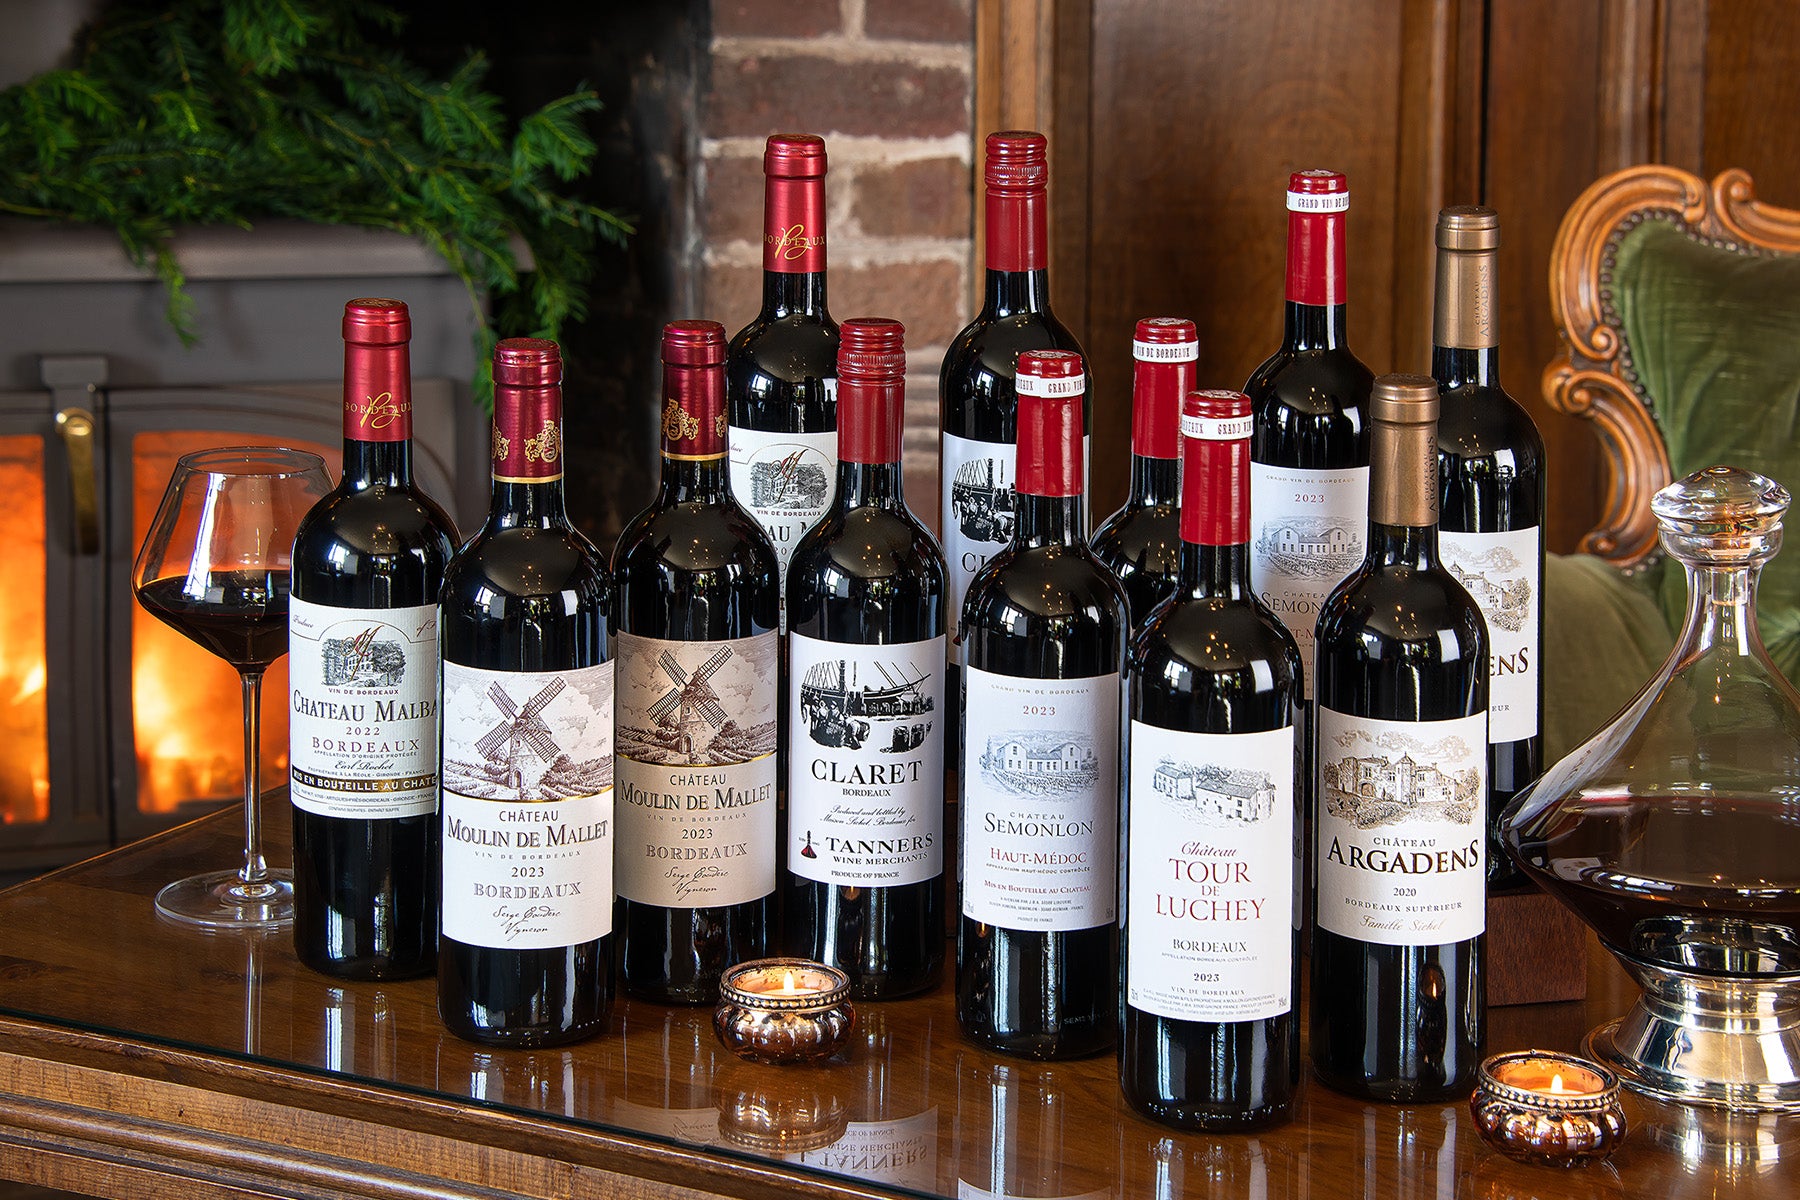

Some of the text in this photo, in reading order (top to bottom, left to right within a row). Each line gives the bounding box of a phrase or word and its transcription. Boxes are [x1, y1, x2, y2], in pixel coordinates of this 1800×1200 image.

[1298, 198, 1318, 208] GRAND
[1480, 264, 1488, 337] ARGADENS
[1156, 347, 1190, 358] BORDEAUX
[1048, 382, 1071, 394] GRAND
[1218, 423, 1240, 435] GRAND
[1428, 436, 1436, 512] ARGADENS
[1294, 493, 1326, 504] 2023
[1284, 590, 1327, 599] CHATEA
[1261, 592, 1323, 615] SEMON
[991, 684, 1014, 692] GRAND
[294, 690, 365, 722] CHATEAU
[1023, 705, 1056, 716] 2023
[346, 726, 380, 736] 2022
[312, 736, 420, 753] BORDEAUX
[314, 750, 350, 758] APPELLATION
[335, 760, 354, 770] Earl
[811, 758, 922, 786] CLARET
[305, 774, 314, 785] EN
[318, 776, 378, 790] BOUTEILLE
[383, 781, 398, 790] AU
[403, 776, 436, 789] CHATE
[670, 774, 726, 786] CHÂTEAU
[621, 780, 772, 810] MOULIN DE MALLET
[842, 788, 892, 798] BORDEAUX
[499, 809, 559, 822] CHÂTEAU
[692, 813, 746, 822] BORDEAUX
[830, 805, 906, 818] Produced and bottled by
[1010, 812, 1065, 820] CHATEAU
[984, 812, 1094, 837] SEMONLON
[447, 814, 608, 848] MOULIN DE MALLET
[682, 828, 713, 840] 2023
[826, 832, 934, 855] TANNERS
[1374, 837, 1436, 848] CHÂTEAU
[522, 850, 582, 860] BORDEAUX
[646, 843, 748, 860] BORDEAUX
[1182, 841, 1237, 857] Château
[1327, 836, 1479, 874] ARGADENS
[832, 852, 928, 865] WINE MERCHANTS
[990, 847, 1087, 865] HAUT-MÉDOC
[511, 866, 545, 878] 2023
[831, 870, 862, 878] PRODUCE
[1060, 866, 1090, 874] CONTRÔLÉE
[1169, 858, 1252, 884] TOUR
[474, 882, 582, 899] BORDEAUX
[1008, 884, 1047, 894] BOUTEILLE
[1060, 885, 1092, 894] CHATEAU
[1202, 885, 1220, 896] DE
[1394, 888, 1416, 896] 2020
[1156, 894, 1265, 921] LUCHEY
[1345, 898, 1462, 912] BORDEAUX SUPÉRIEUR
[1360, 914, 1402, 930] Famille
[1173, 938, 1247, 952] BORDEAUX
[1162, 952, 1196, 961] APPELLATION
[1194, 972, 1220, 982] 2023
[1171, 986, 1185, 994] VIN
[1202, 988, 1245, 996] BORDEAUX
